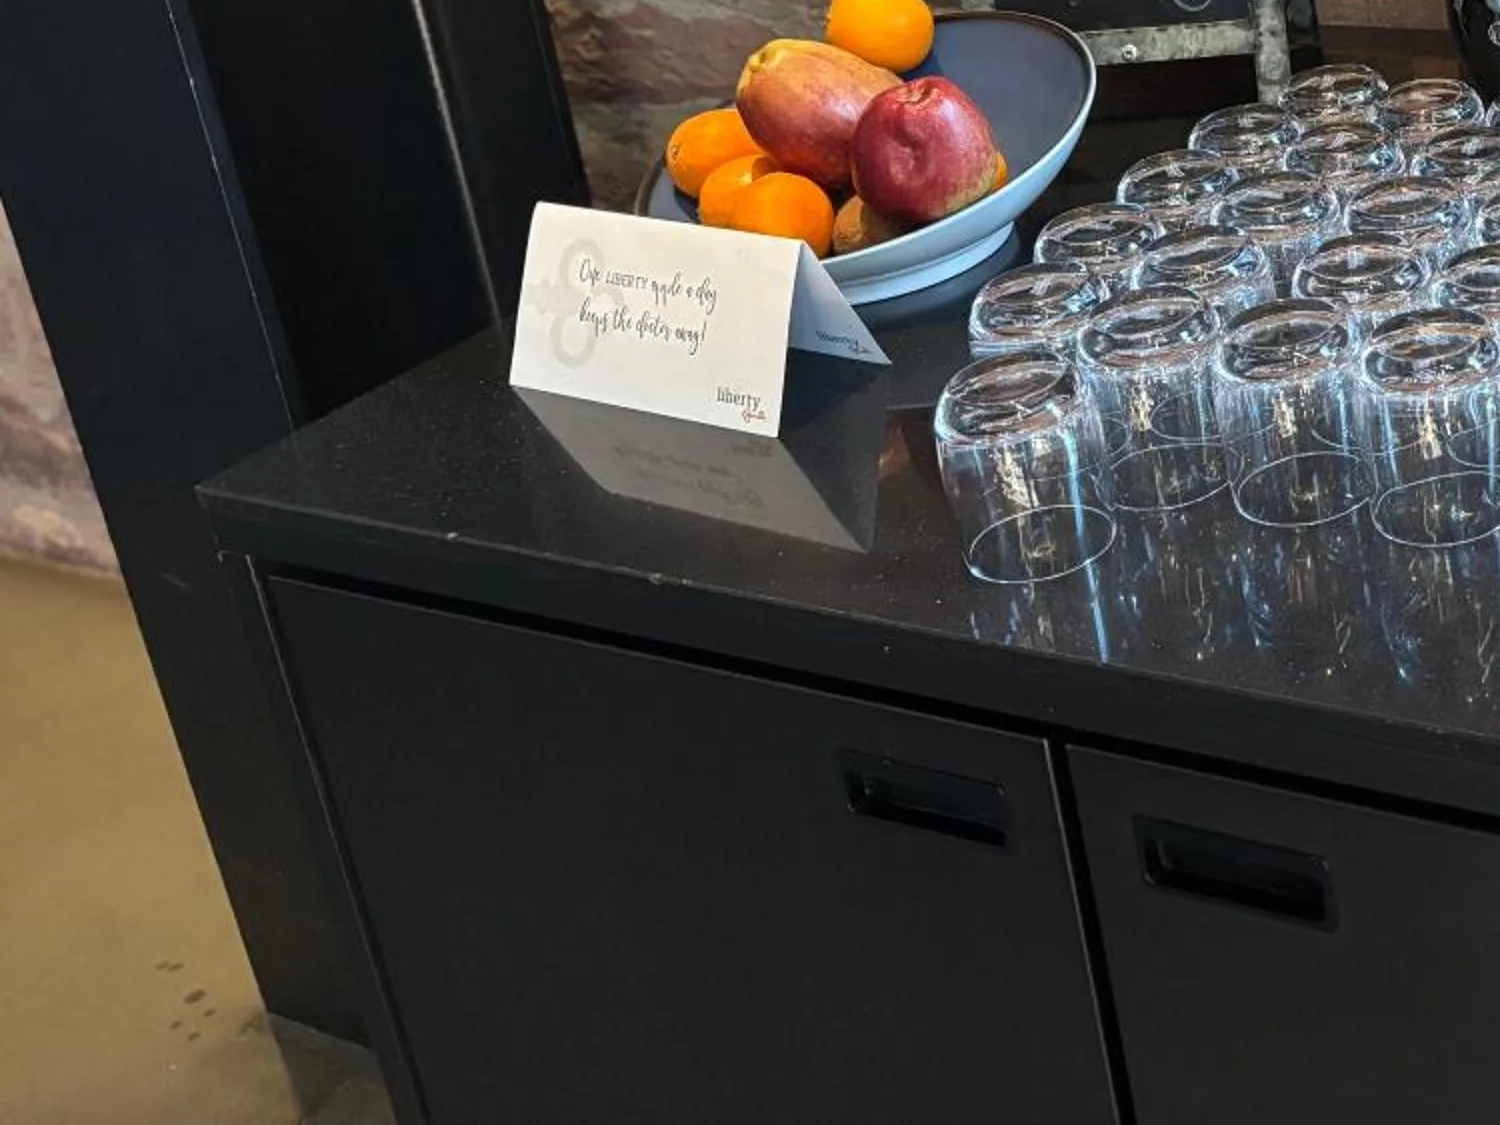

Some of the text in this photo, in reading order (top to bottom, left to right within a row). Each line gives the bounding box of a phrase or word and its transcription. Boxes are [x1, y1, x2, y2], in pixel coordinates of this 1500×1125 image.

[605, 270, 649, 290] LIBERTY
[695, 275, 717, 316] day
[579, 296, 608, 338] keeps
[613, 306, 633, 332] the
[635, 310, 672, 343] doctor
[716, 385, 761, 412] liberty
